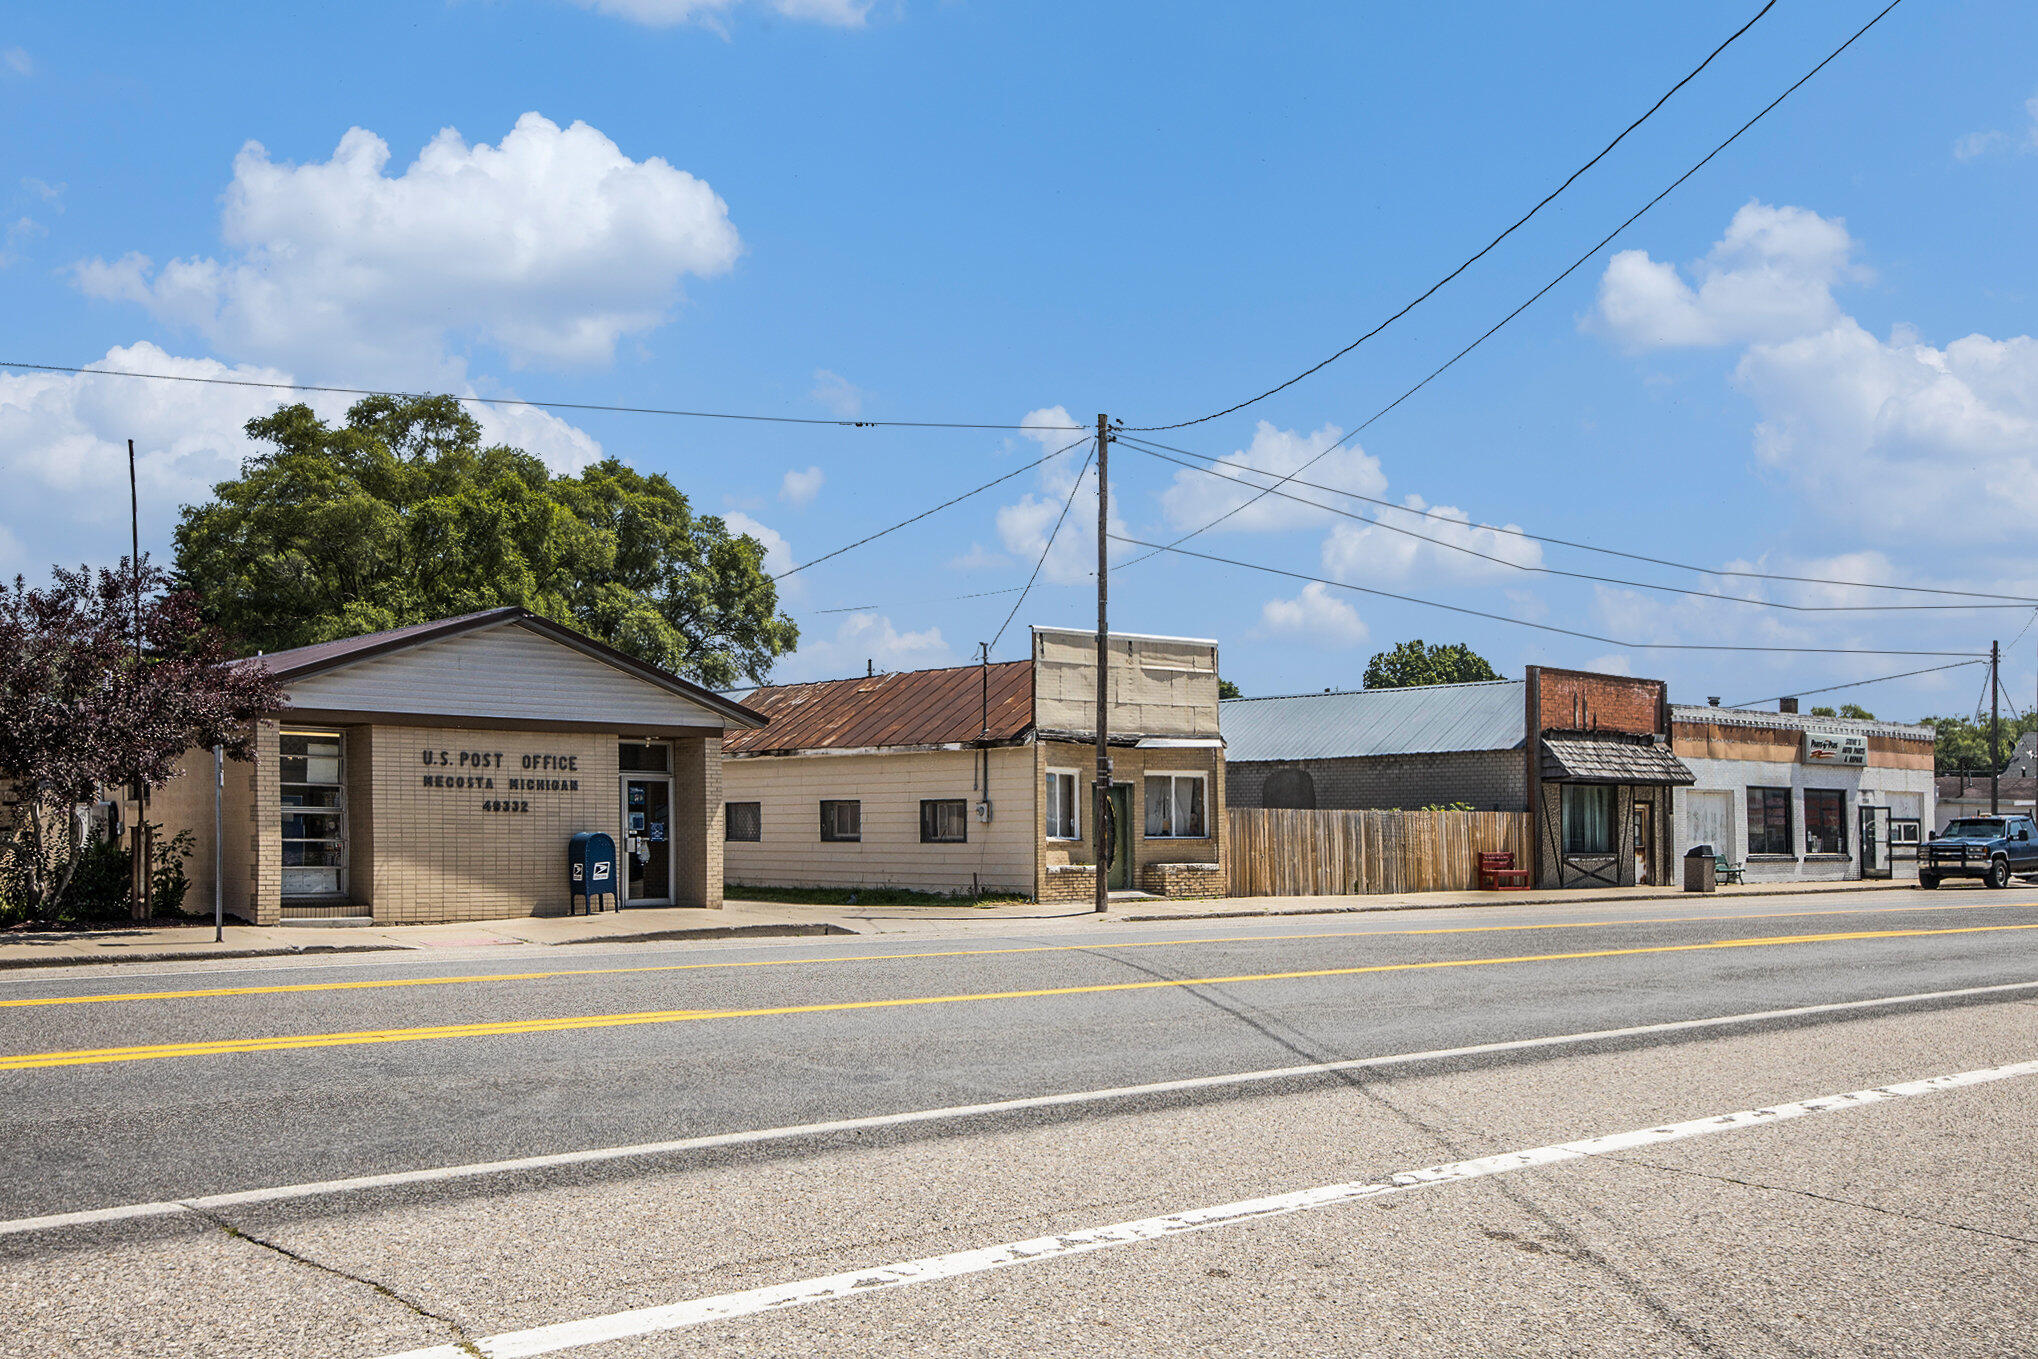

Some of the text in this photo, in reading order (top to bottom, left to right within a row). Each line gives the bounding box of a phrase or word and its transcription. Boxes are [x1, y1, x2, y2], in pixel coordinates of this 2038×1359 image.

[423, 750, 578, 771] U.S. POST OFFICE
[423, 775, 579, 791] MECOSTA MICHIGAN
